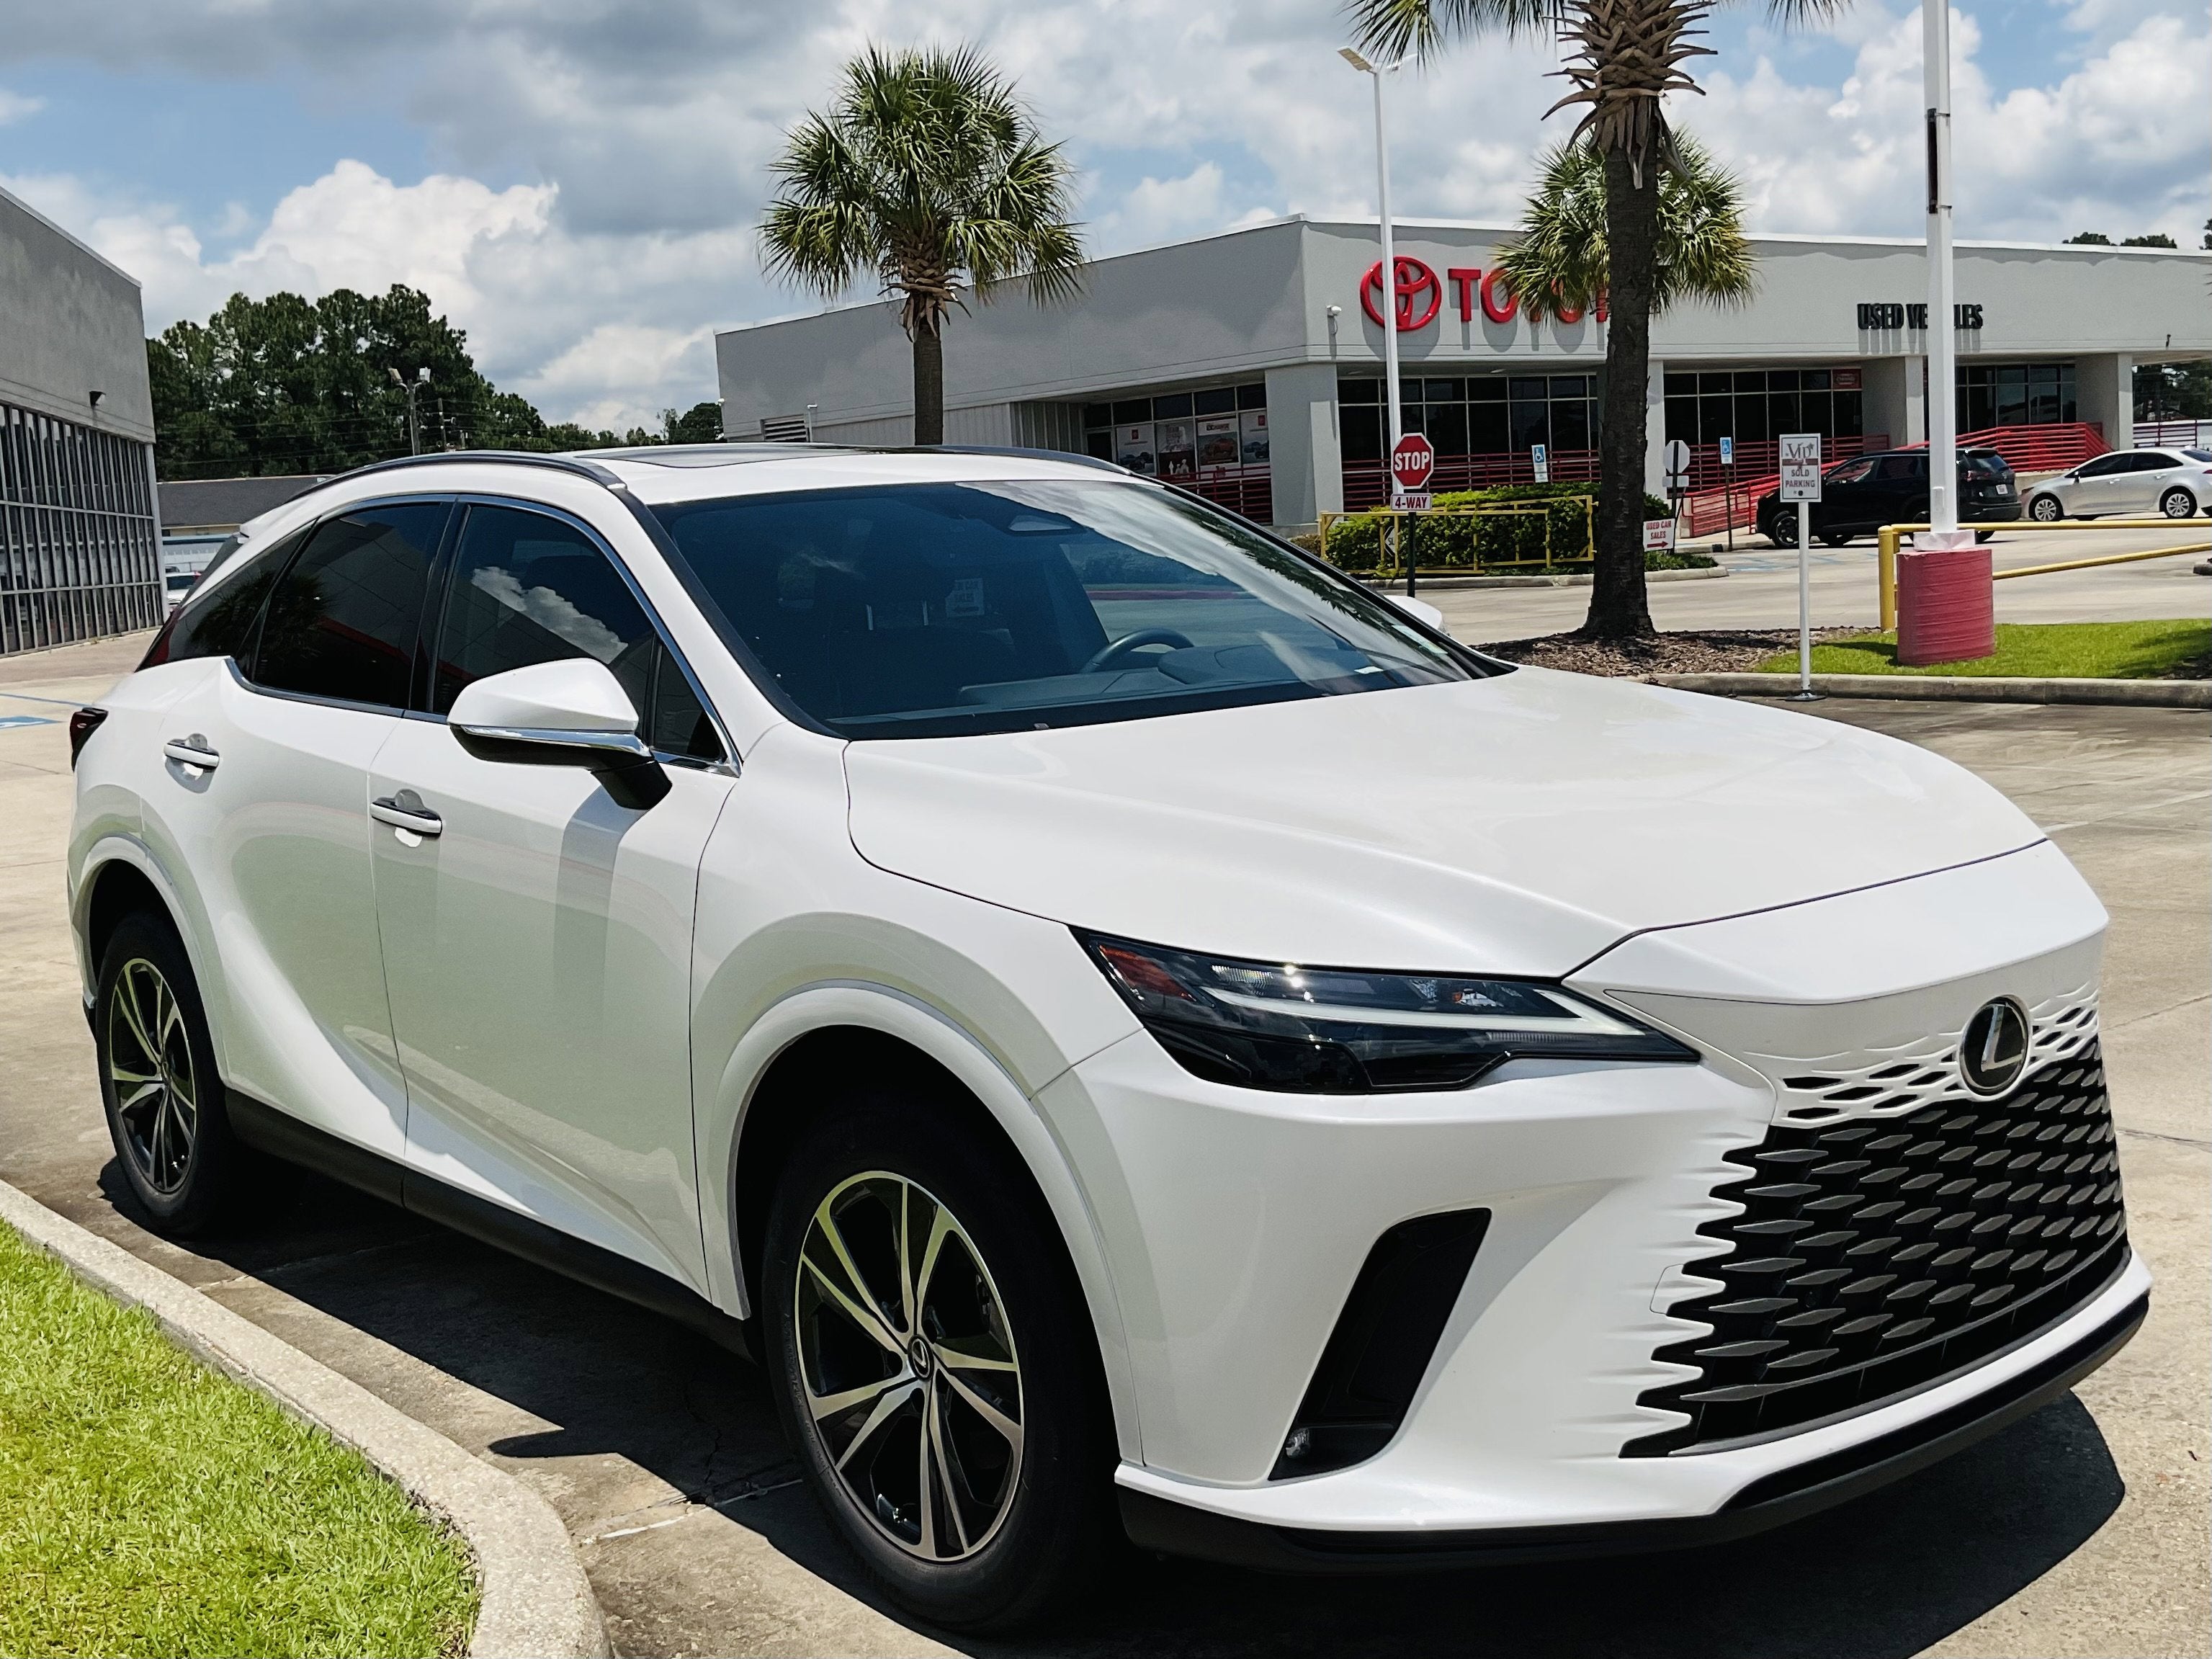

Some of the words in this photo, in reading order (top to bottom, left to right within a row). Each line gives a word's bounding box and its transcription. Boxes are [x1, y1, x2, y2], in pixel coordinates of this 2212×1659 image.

[1857, 303, 1904, 329] USED
[1906, 303, 1984, 329] VELES
[1394, 451, 1430, 471] STOP
[1394, 496, 1428, 509] 4-WAY
[1646, 522, 1660, 530] USED
[1661, 520, 1672, 529] CAR
[1650, 531, 1666, 540] SALES
